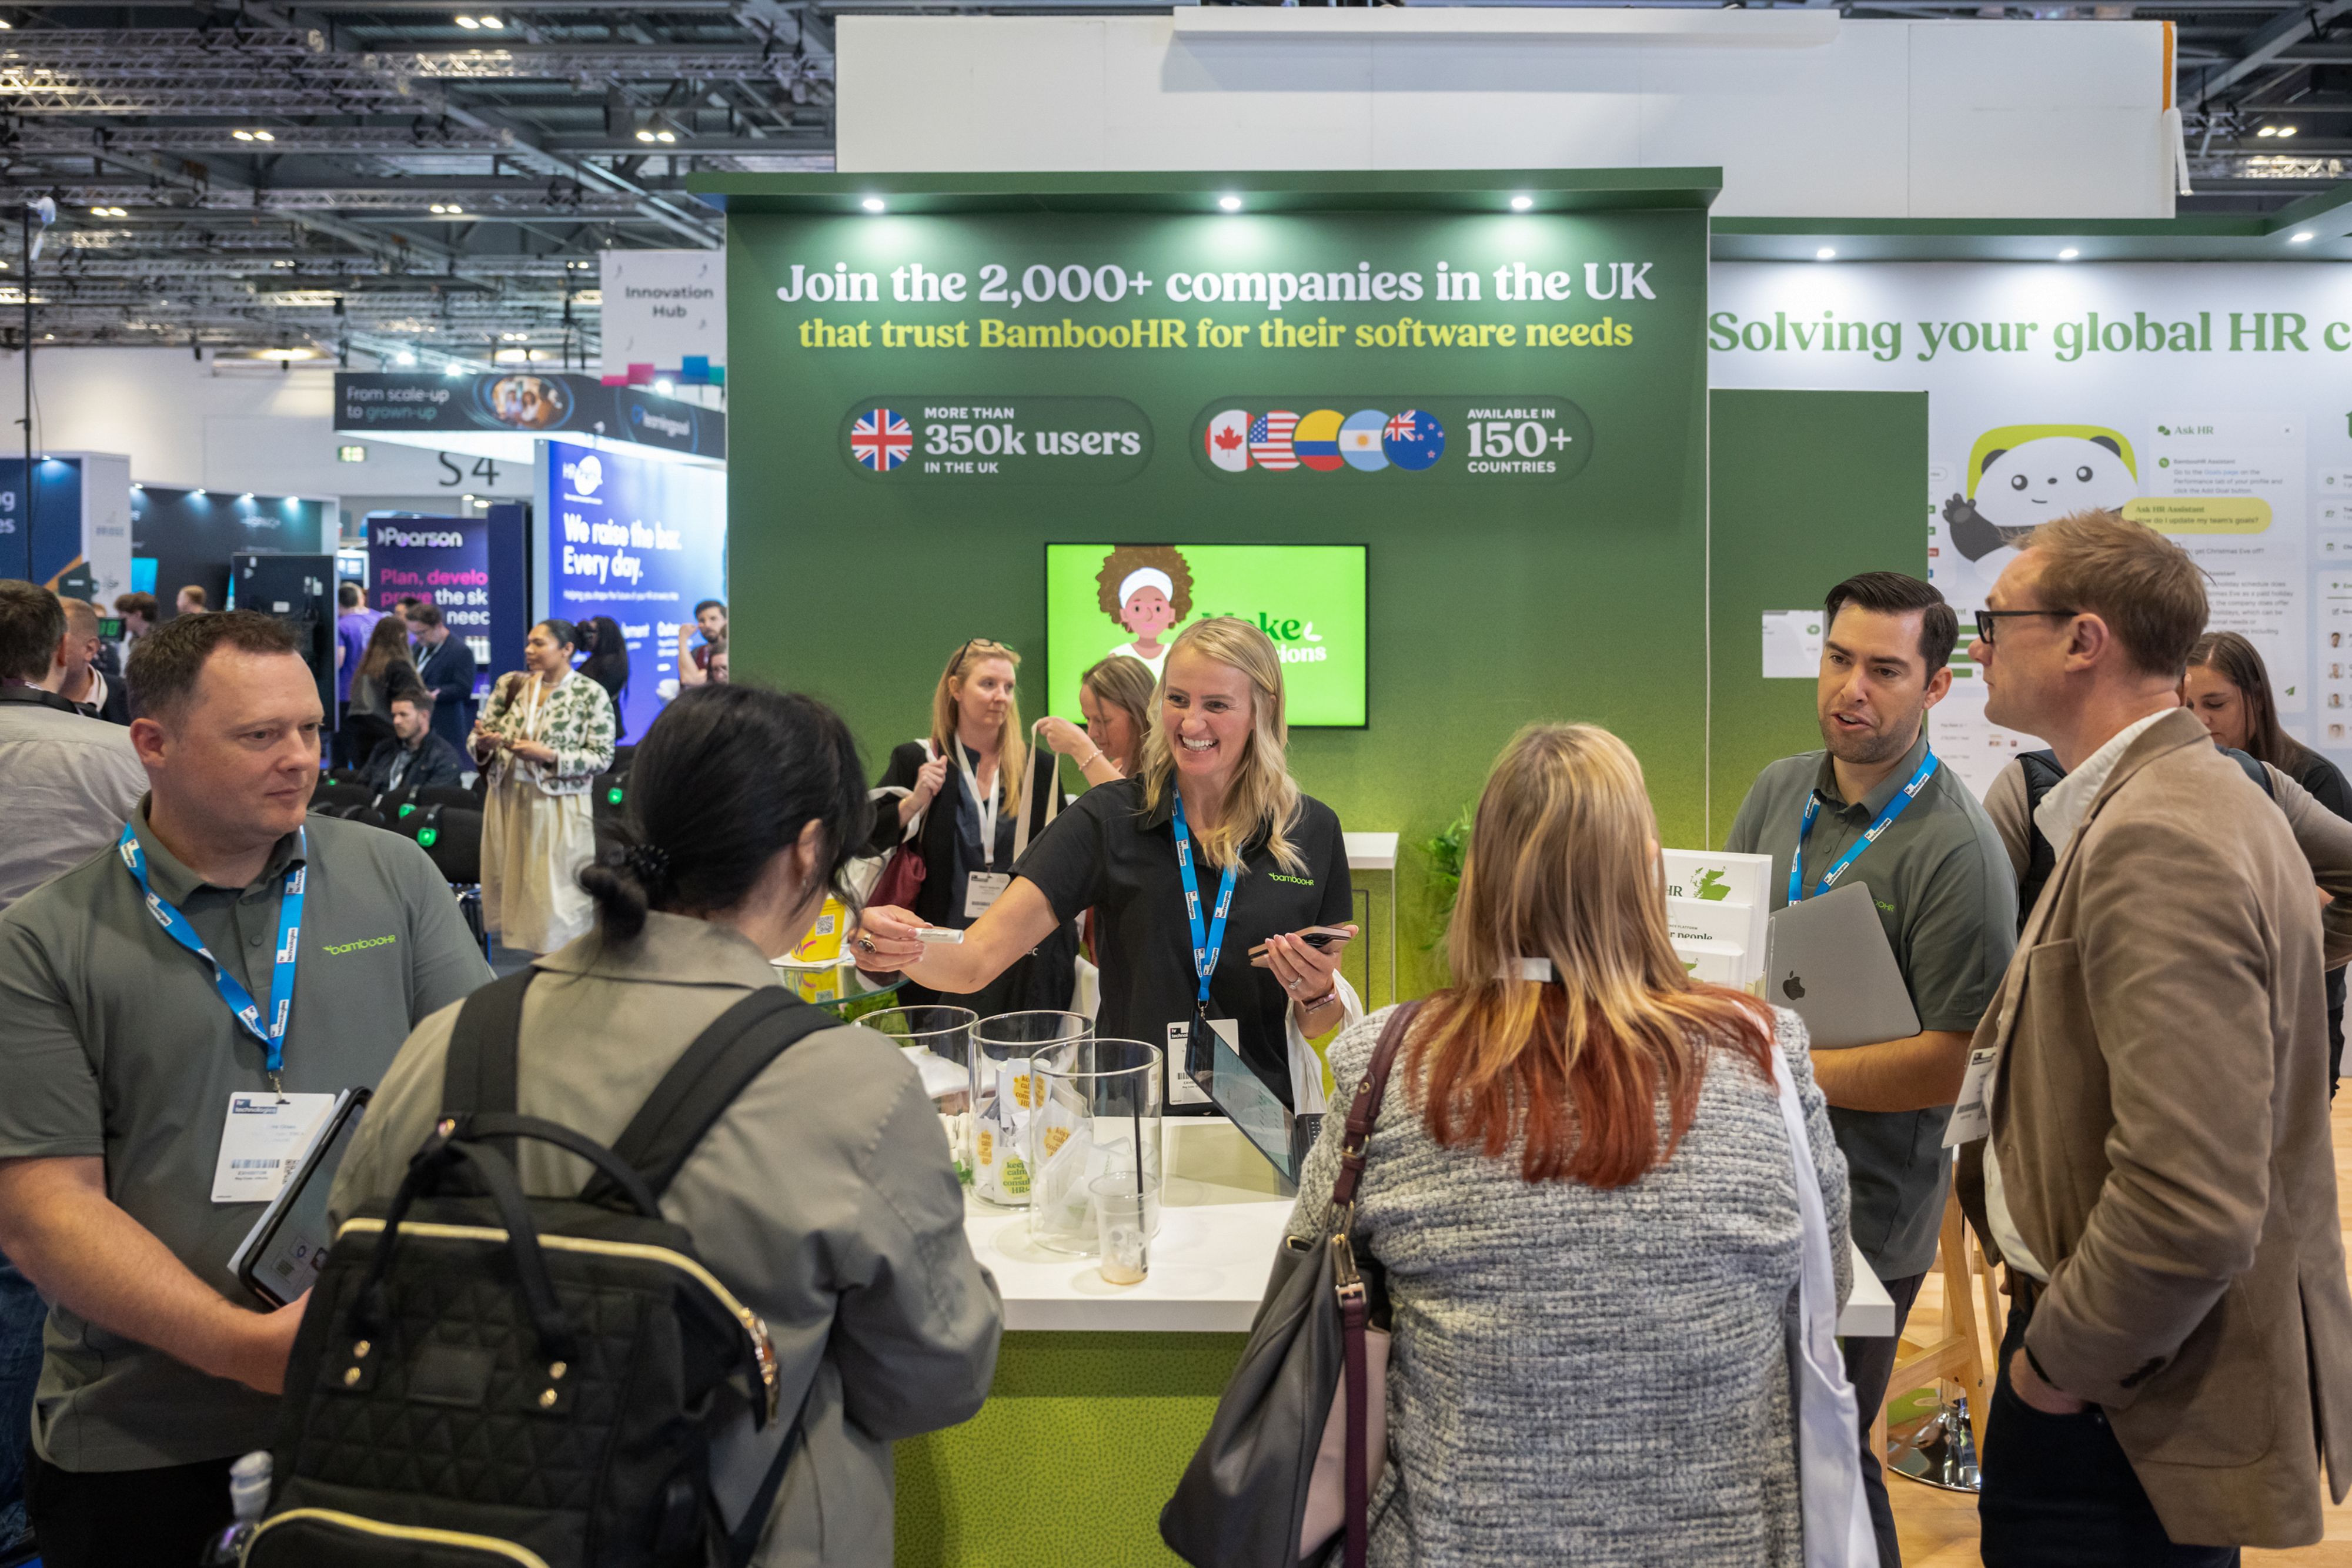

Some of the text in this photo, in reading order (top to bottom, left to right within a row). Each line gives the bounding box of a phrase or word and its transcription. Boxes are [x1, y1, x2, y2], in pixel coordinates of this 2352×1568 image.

[626, 286, 713, 299] Innovation
[777, 262, 1656, 310] Join the 2,000+ companies in the UK
[653, 305, 687, 317] Hub
[799, 317, 1633, 347] that trust BambooHR for their software needs
[1709, 310, 1902, 361] Solving
[1917, 320, 2037, 361] your
[2054, 312, 2210, 361] global
[2229, 313, 2309, 351] HR
[347, 386, 450, 405] From scale-up
[347, 404, 437, 423] to grown-up
[924, 407, 1014, 419] MORE THAN
[1468, 409, 1555, 419] AVAILABLE IN
[924, 424, 1141, 455] 350k users
[2175, 426, 2214, 434] Ask HR
[1468, 423, 1572, 457] 150+
[924, 462, 998, 473] IN THE UK
[1468, 462, 1556, 473] COUNTRIES
[2250, 478, 2270, 486] profile
[385, 527, 463, 547] Pearson
[563, 513, 590, 543] We
[592, 519, 630, 547] raise
[630, 519, 655, 549] the
[563, 545, 644, 586] Every day.
[380, 569, 423, 587] Plan,
[435, 588, 466, 606] the
[1276, 644, 1327, 664] ions
